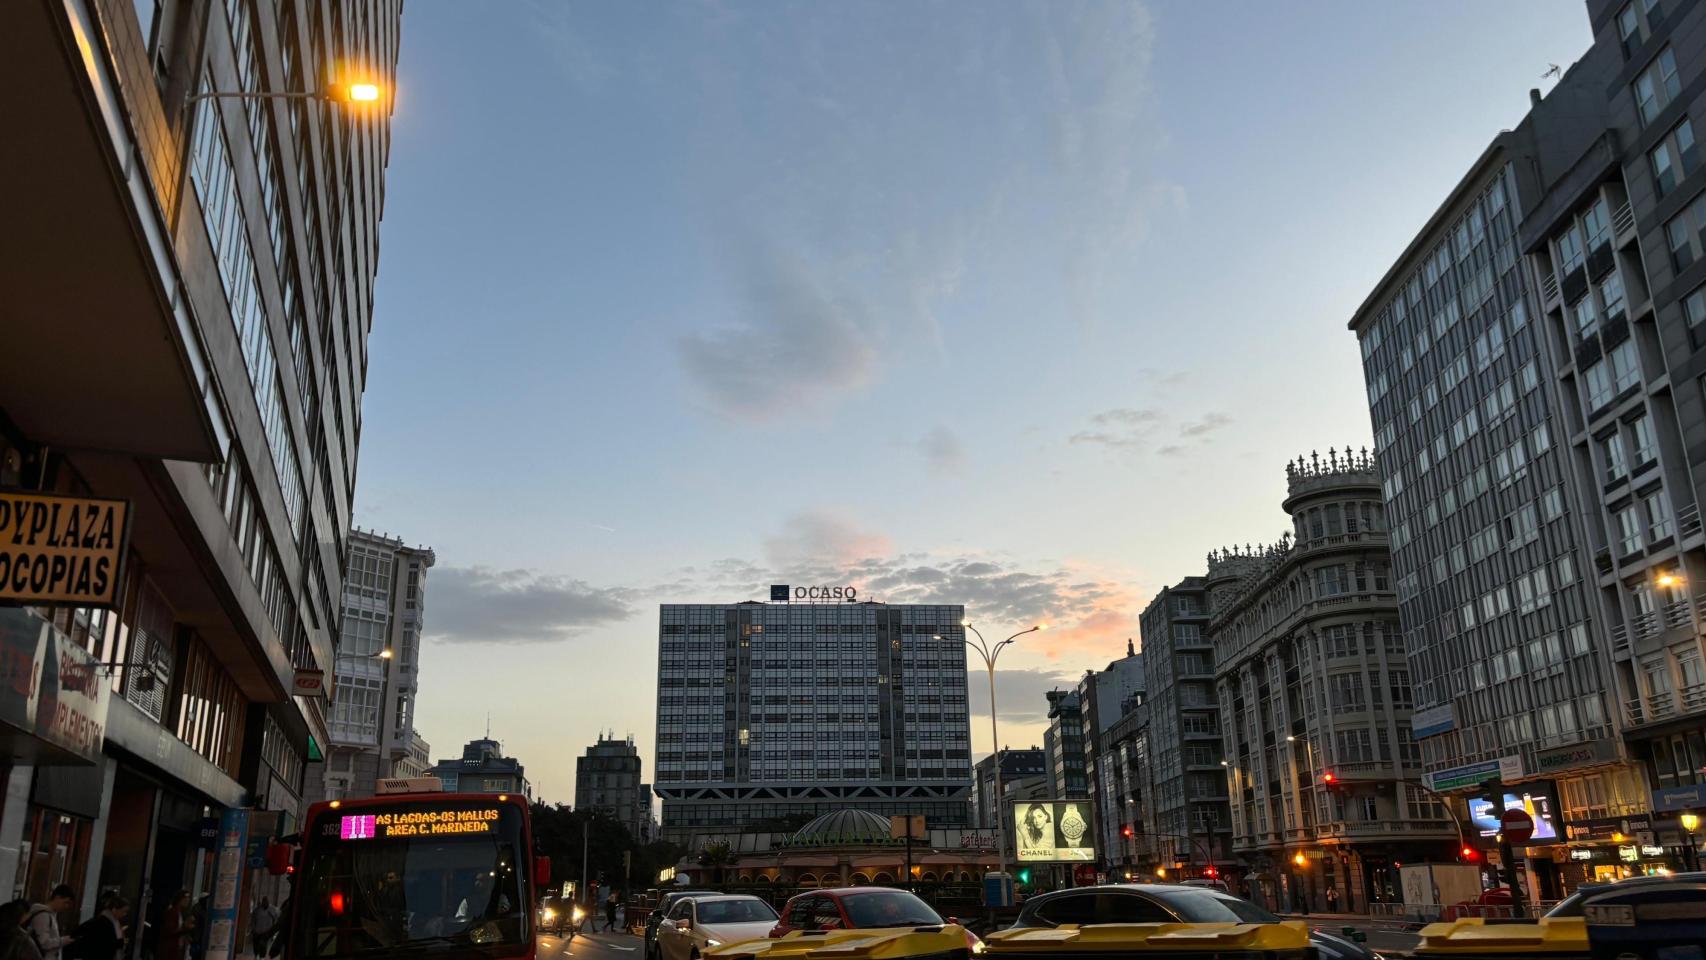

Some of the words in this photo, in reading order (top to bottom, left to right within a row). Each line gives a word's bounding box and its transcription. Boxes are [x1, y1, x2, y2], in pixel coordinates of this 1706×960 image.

[795, 585, 857, 599] OCASO
[376, 814, 392, 825] AS
[394, 811, 455, 824] LAGOAS-OS
[457, 809, 499, 822] MALLOS
[349, 815, 366, 838] 11
[419, 823, 430, 834] C.
[431, 820, 489, 834] MARINEDA
[1020, 849, 1053, 857] CHANEL
